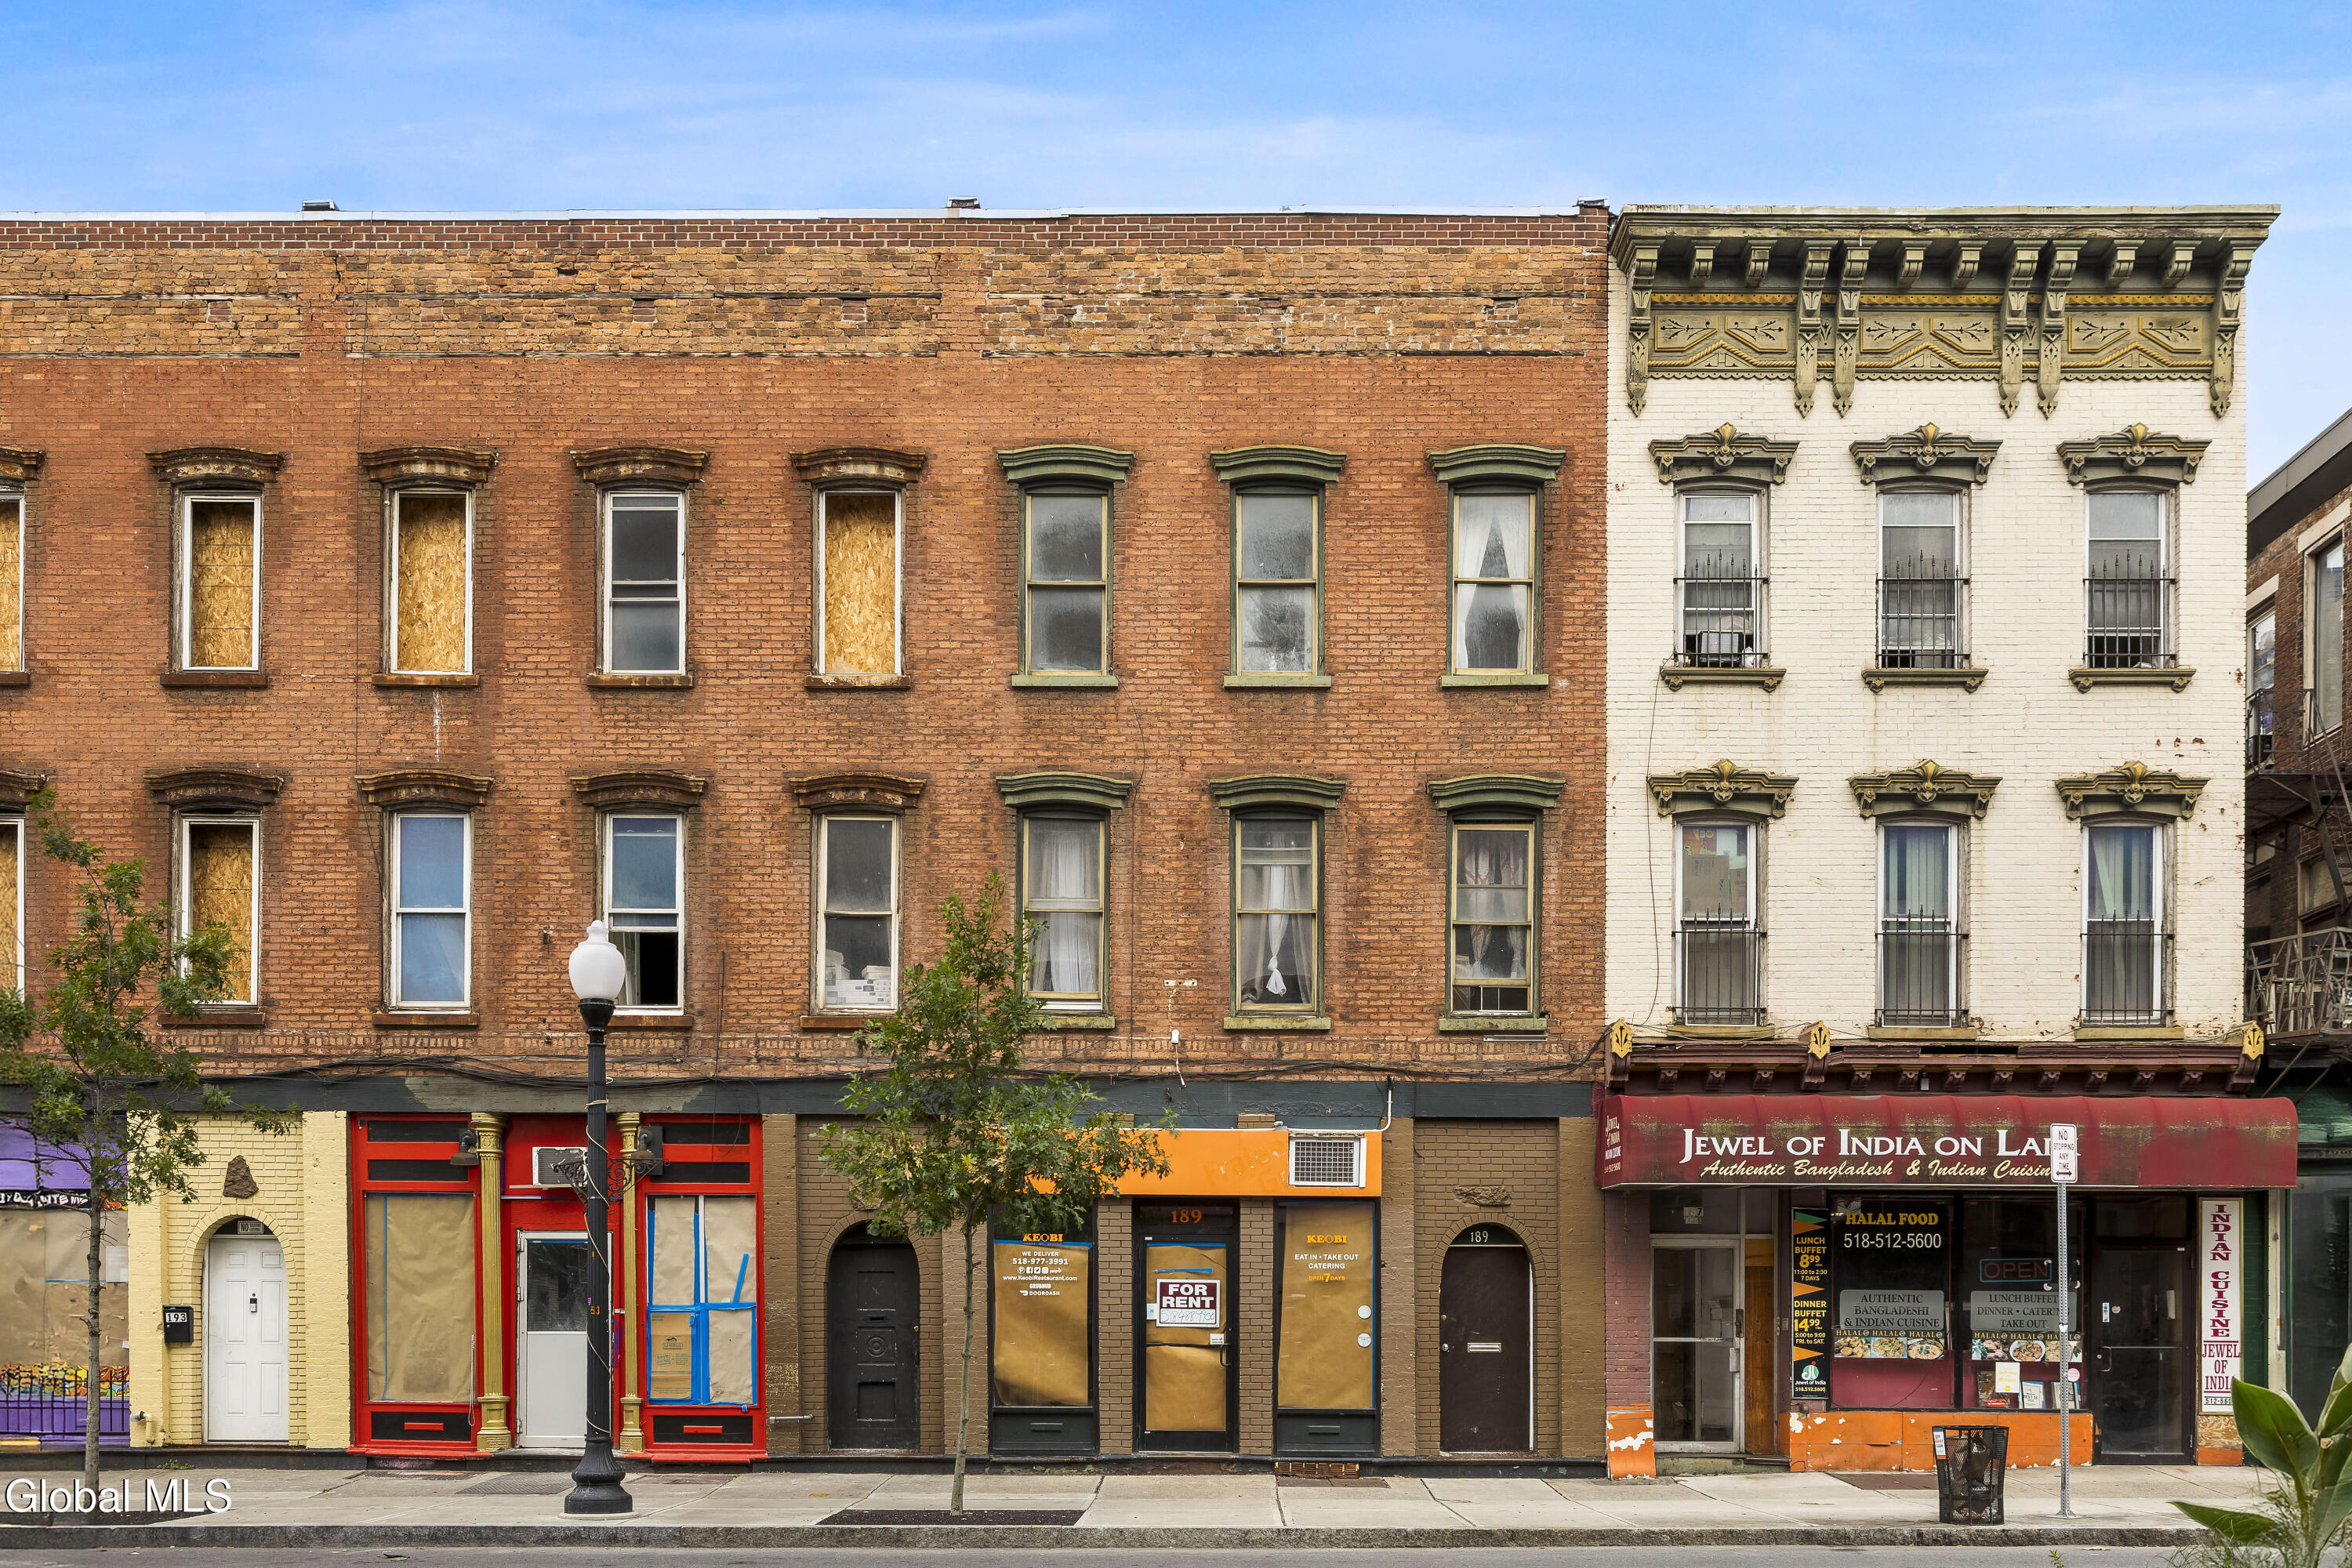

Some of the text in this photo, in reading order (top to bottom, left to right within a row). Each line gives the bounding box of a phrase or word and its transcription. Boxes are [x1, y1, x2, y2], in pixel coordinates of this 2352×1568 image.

[2058, 1130, 2068, 1141] NO
[1679, 1128, 1774, 1163] JEWEL
[1786, 1137, 1826, 1156] OF
[1838, 1129, 1926, 1156] INDIA
[1934, 1137, 1984, 1156] ON
[2053, 1142, 2074, 1151] STOPPING
[1700, 1159, 2052, 1181] Authentic Bangladesh & Indian Cuisin
[2058, 1162, 2070, 1171] TIME
[1171, 1209, 1203, 1224] 189
[1845, 1213, 1939, 1225] HALAL FOOD
[241, 1223, 249, 1232] NO
[2209, 1204, 2232, 1261] INDIAN
[1022, 1233, 1064, 1242] KEOBI
[1306, 1235, 1348, 1243] KEOBI
[1470, 1230, 1489, 1243] 189
[1844, 1232, 1942, 1248] 518-512-5600
[1795, 1246, 1827, 1254] BUFFET
[1984, 1261, 2049, 1279] OPEN
[1323, 1272, 1331, 1283] 7
[1168, 1283, 1208, 1296] FOR
[1162, 1296, 1214, 1308] RENT
[1860, 1294, 1924, 1304] AUTHENTIC
[1989, 1294, 2021, 1303] LUNCH
[2209, 1270, 2231, 1338] CUISINE
[1853, 1305, 1929, 1316] BANGLADESHI
[1976, 1306, 2014, 1316] DINNER
[167, 1313, 187, 1322] 193
[1843, 1317, 1940, 1327] & INDIAN CUISINE
[2000, 1319, 2048, 1328] TAKE OUT
[2201, 1343, 2241, 1358] JEWEL
[2214, 1359, 2228, 1374] OF
